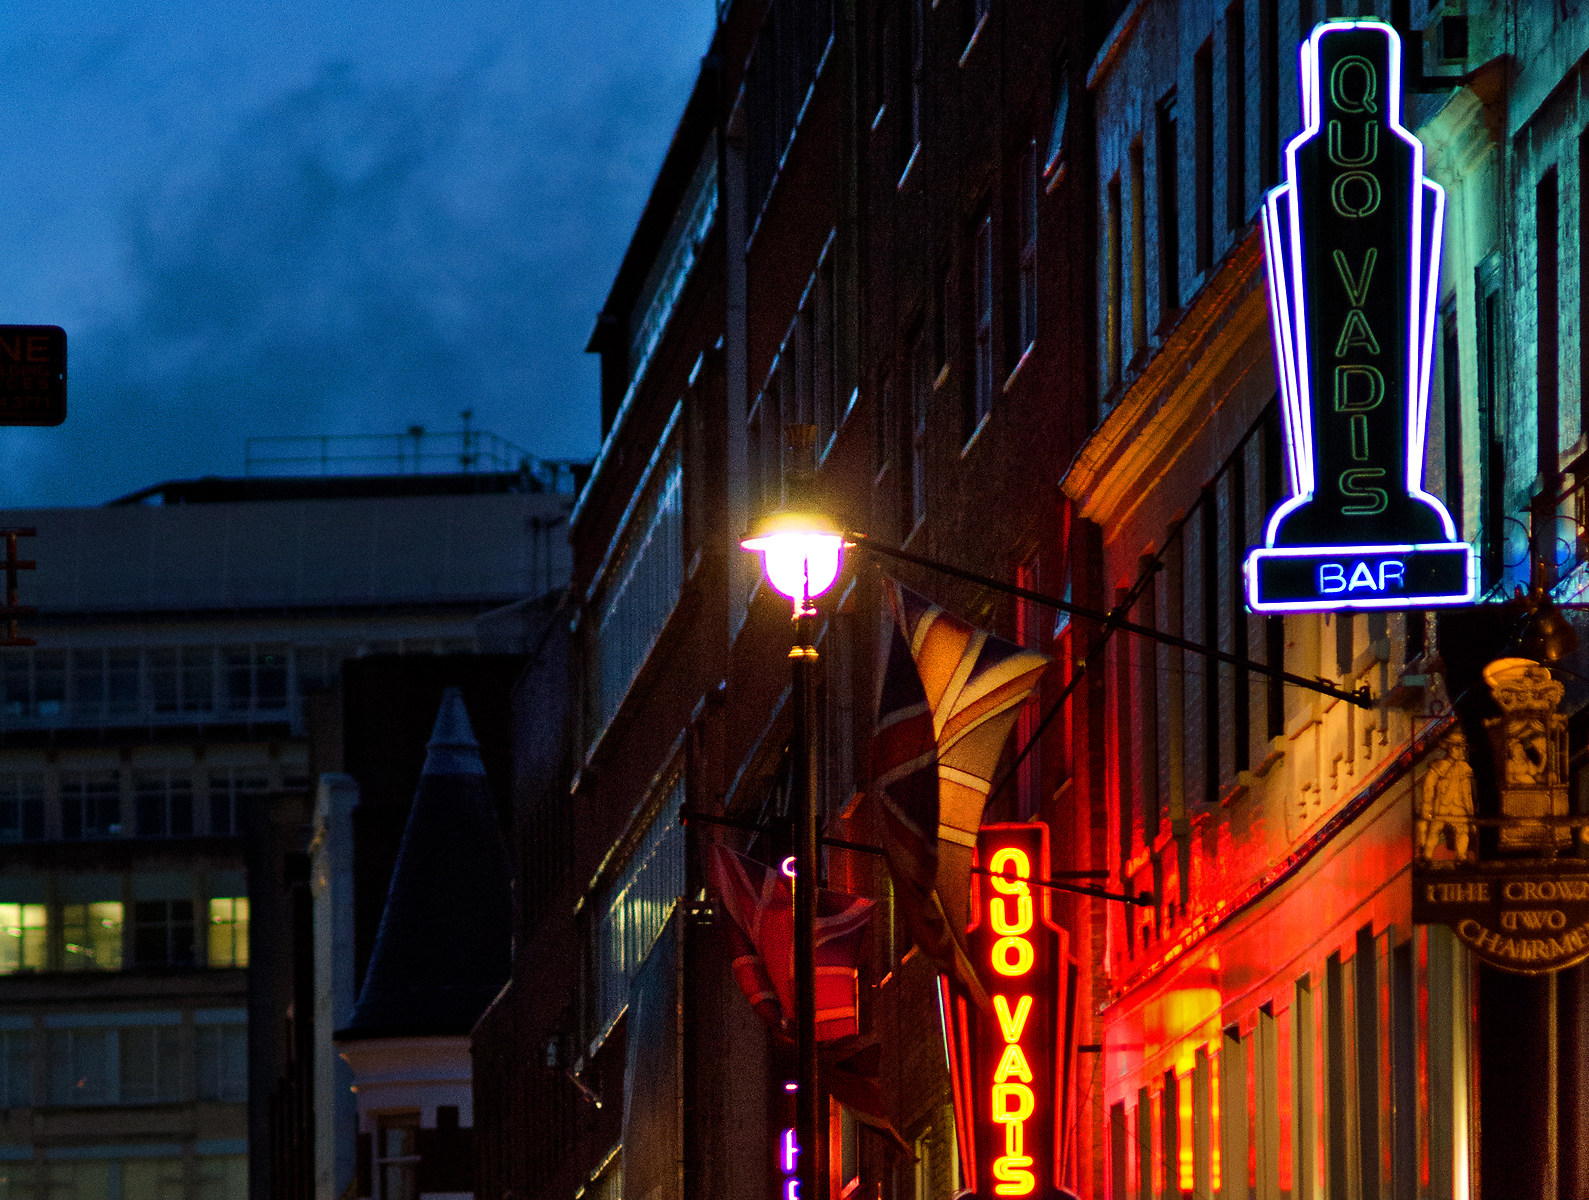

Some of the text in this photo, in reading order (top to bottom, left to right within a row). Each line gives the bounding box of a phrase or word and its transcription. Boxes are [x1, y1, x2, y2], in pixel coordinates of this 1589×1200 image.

[1328, 55, 1389, 516] QUO VADIS
[1319, 561, 1405, 593] BAR
[1501, 910, 1567, 931] TWO
[989, 847, 1036, 1196] QUO VADIS
